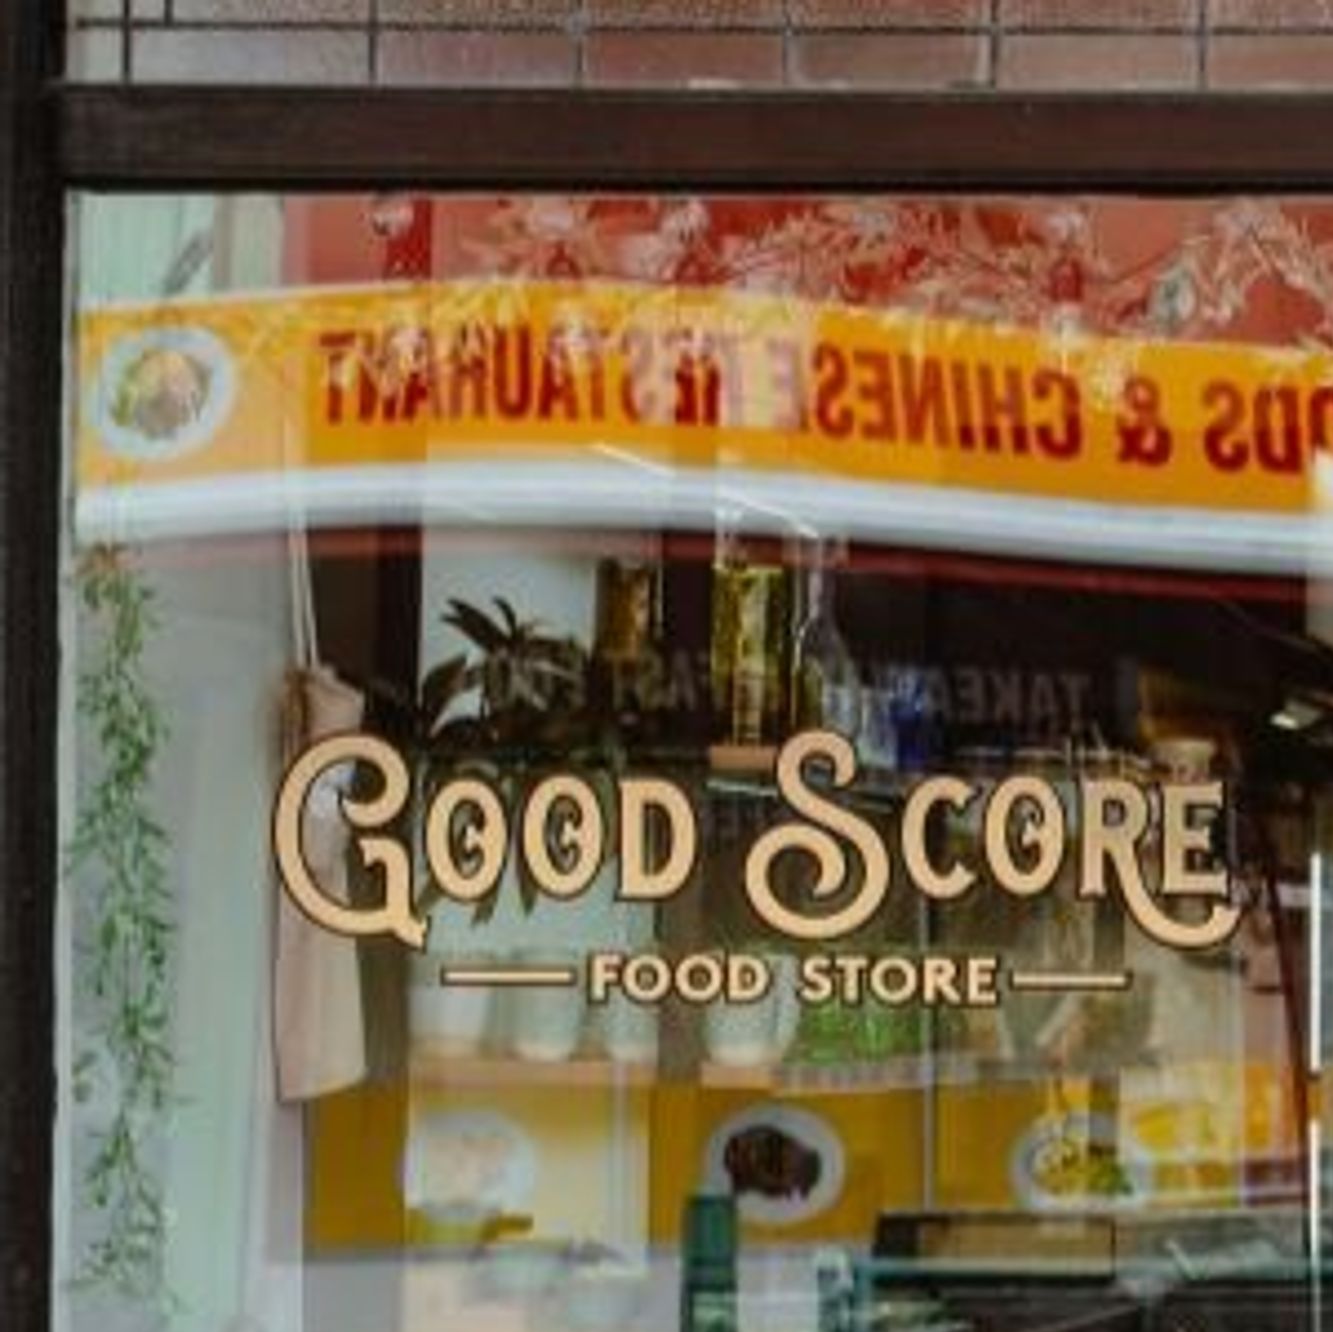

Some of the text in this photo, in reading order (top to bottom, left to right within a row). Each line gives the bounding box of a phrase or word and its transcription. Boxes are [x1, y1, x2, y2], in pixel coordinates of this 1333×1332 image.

[273, 729, 1242, 951] GOOD SCORE
[590, 953, 998, 1004] FOOD STORE
